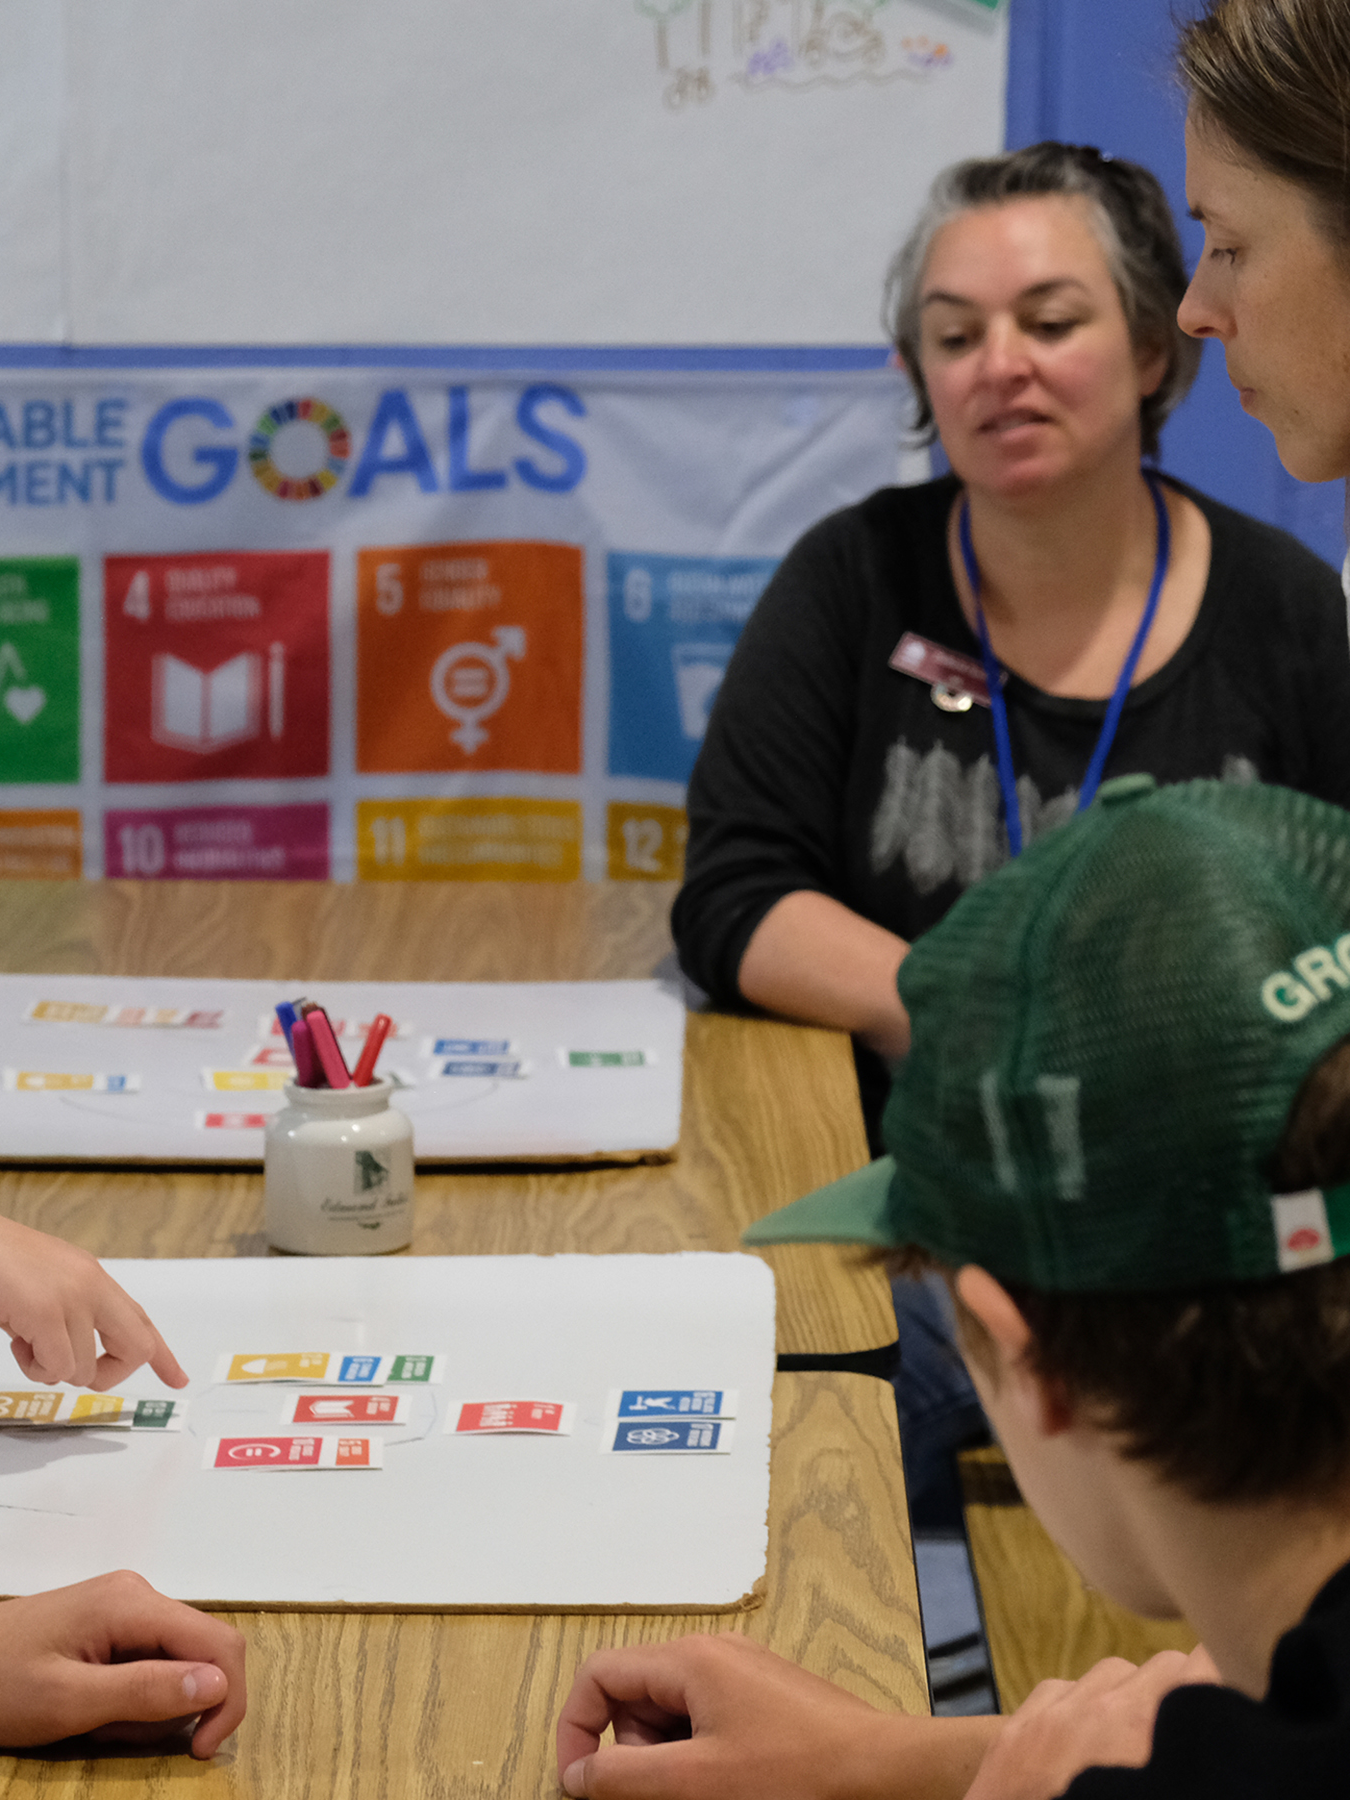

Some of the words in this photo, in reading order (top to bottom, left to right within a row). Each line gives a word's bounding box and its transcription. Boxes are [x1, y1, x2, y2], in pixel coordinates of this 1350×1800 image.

[140, 381, 588, 505] GOALS
[122, 570, 150, 623] 4
[374, 562, 406, 617] 5
[624, 568, 652, 622] 6
[118, 821, 165, 878] 10
[370, 815, 407, 869] 11
[621, 818, 663, 871] 12
